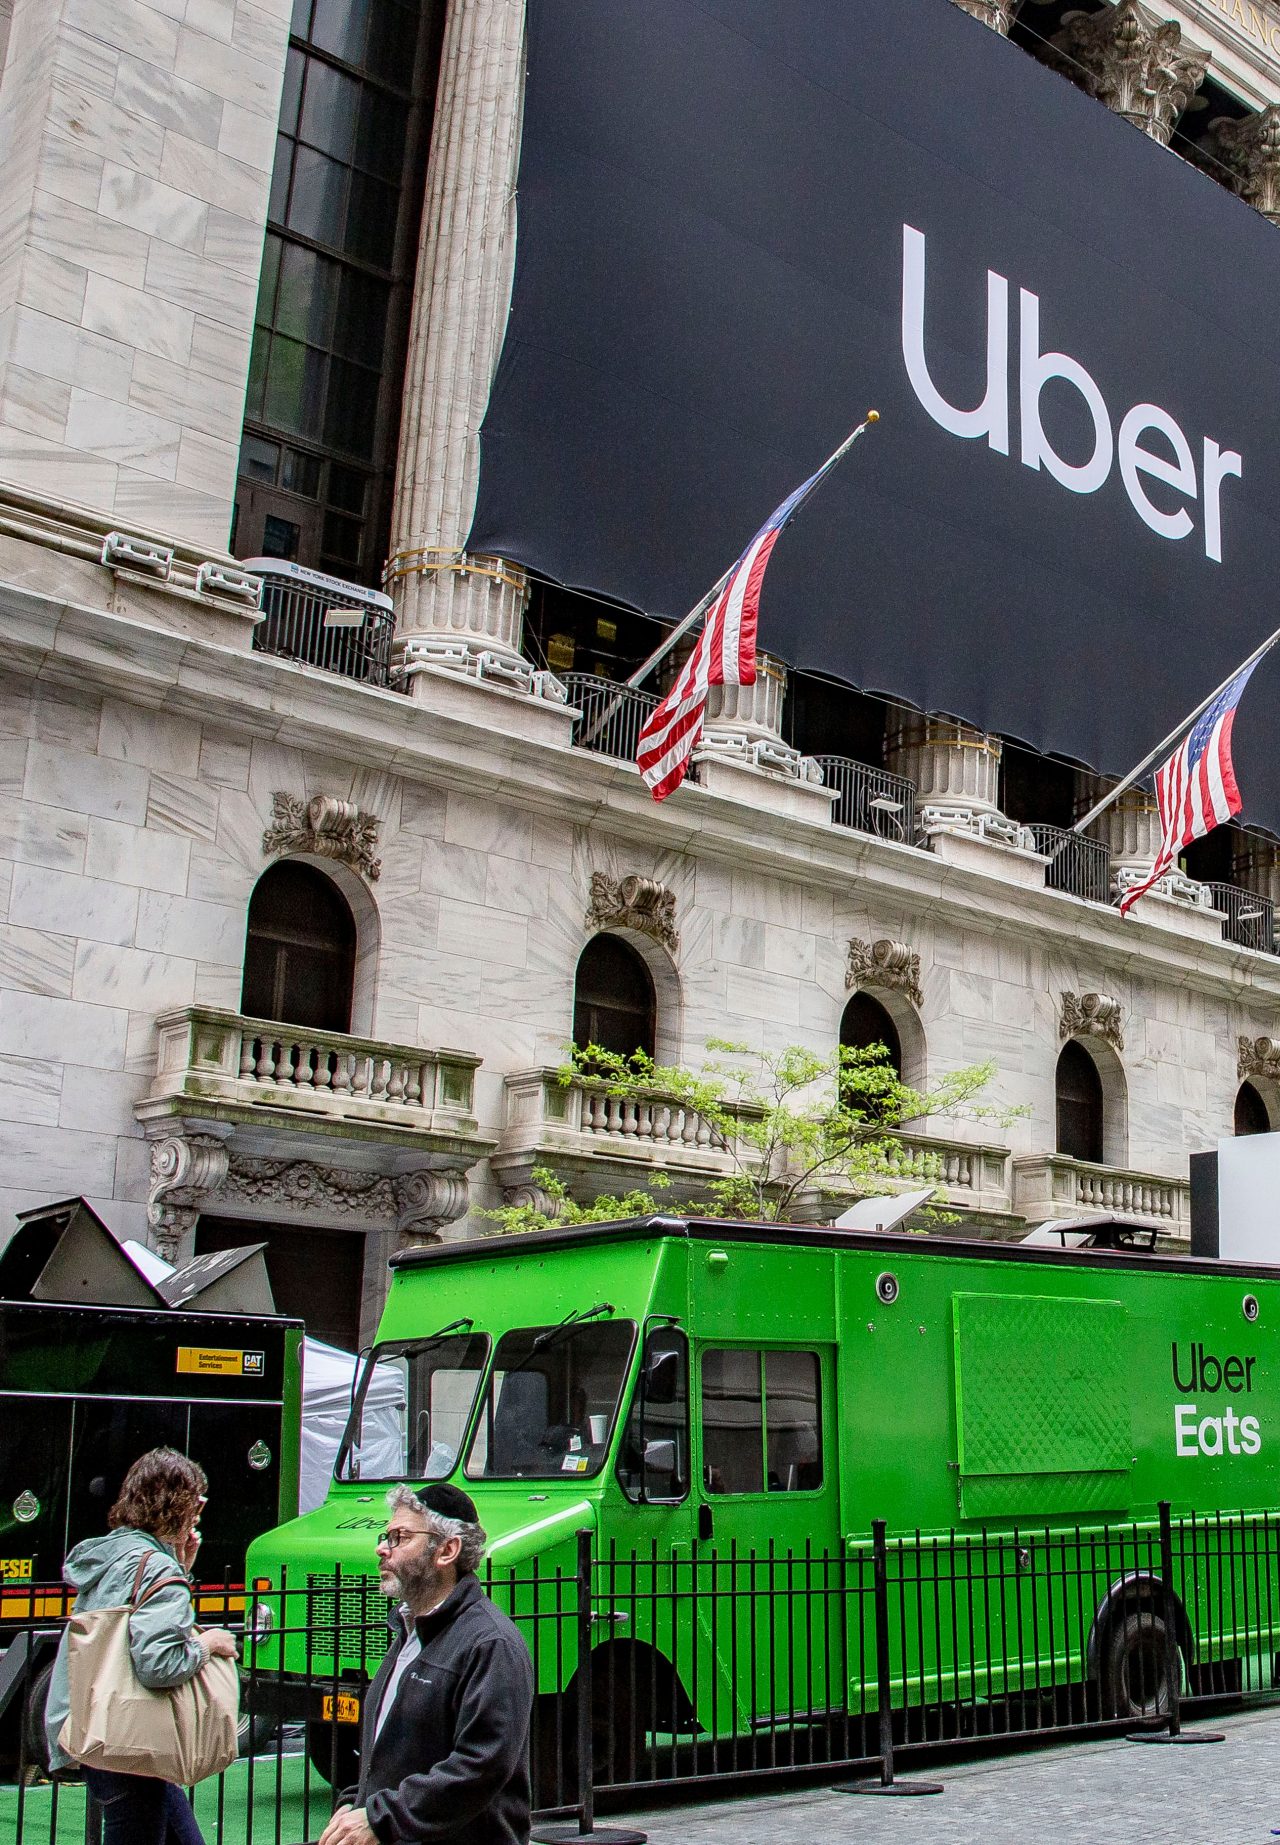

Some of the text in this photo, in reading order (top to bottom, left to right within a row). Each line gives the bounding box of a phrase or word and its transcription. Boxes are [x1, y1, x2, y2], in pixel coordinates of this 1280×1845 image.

[902, 223, 1242, 563] Uber
[312, 573, 324, 581] YORK
[325, 577, 341, 586] STOCK
[342, 583, 367, 595] EXCHANGE
[198, 1361, 223, 1369] Services
[199, 1353, 238, 1362] Entertainment
[244, 1355, 262, 1367] CAT
[1172, 1342, 1256, 1393] Uber
[1174, 1404, 1261, 1456] Eats
